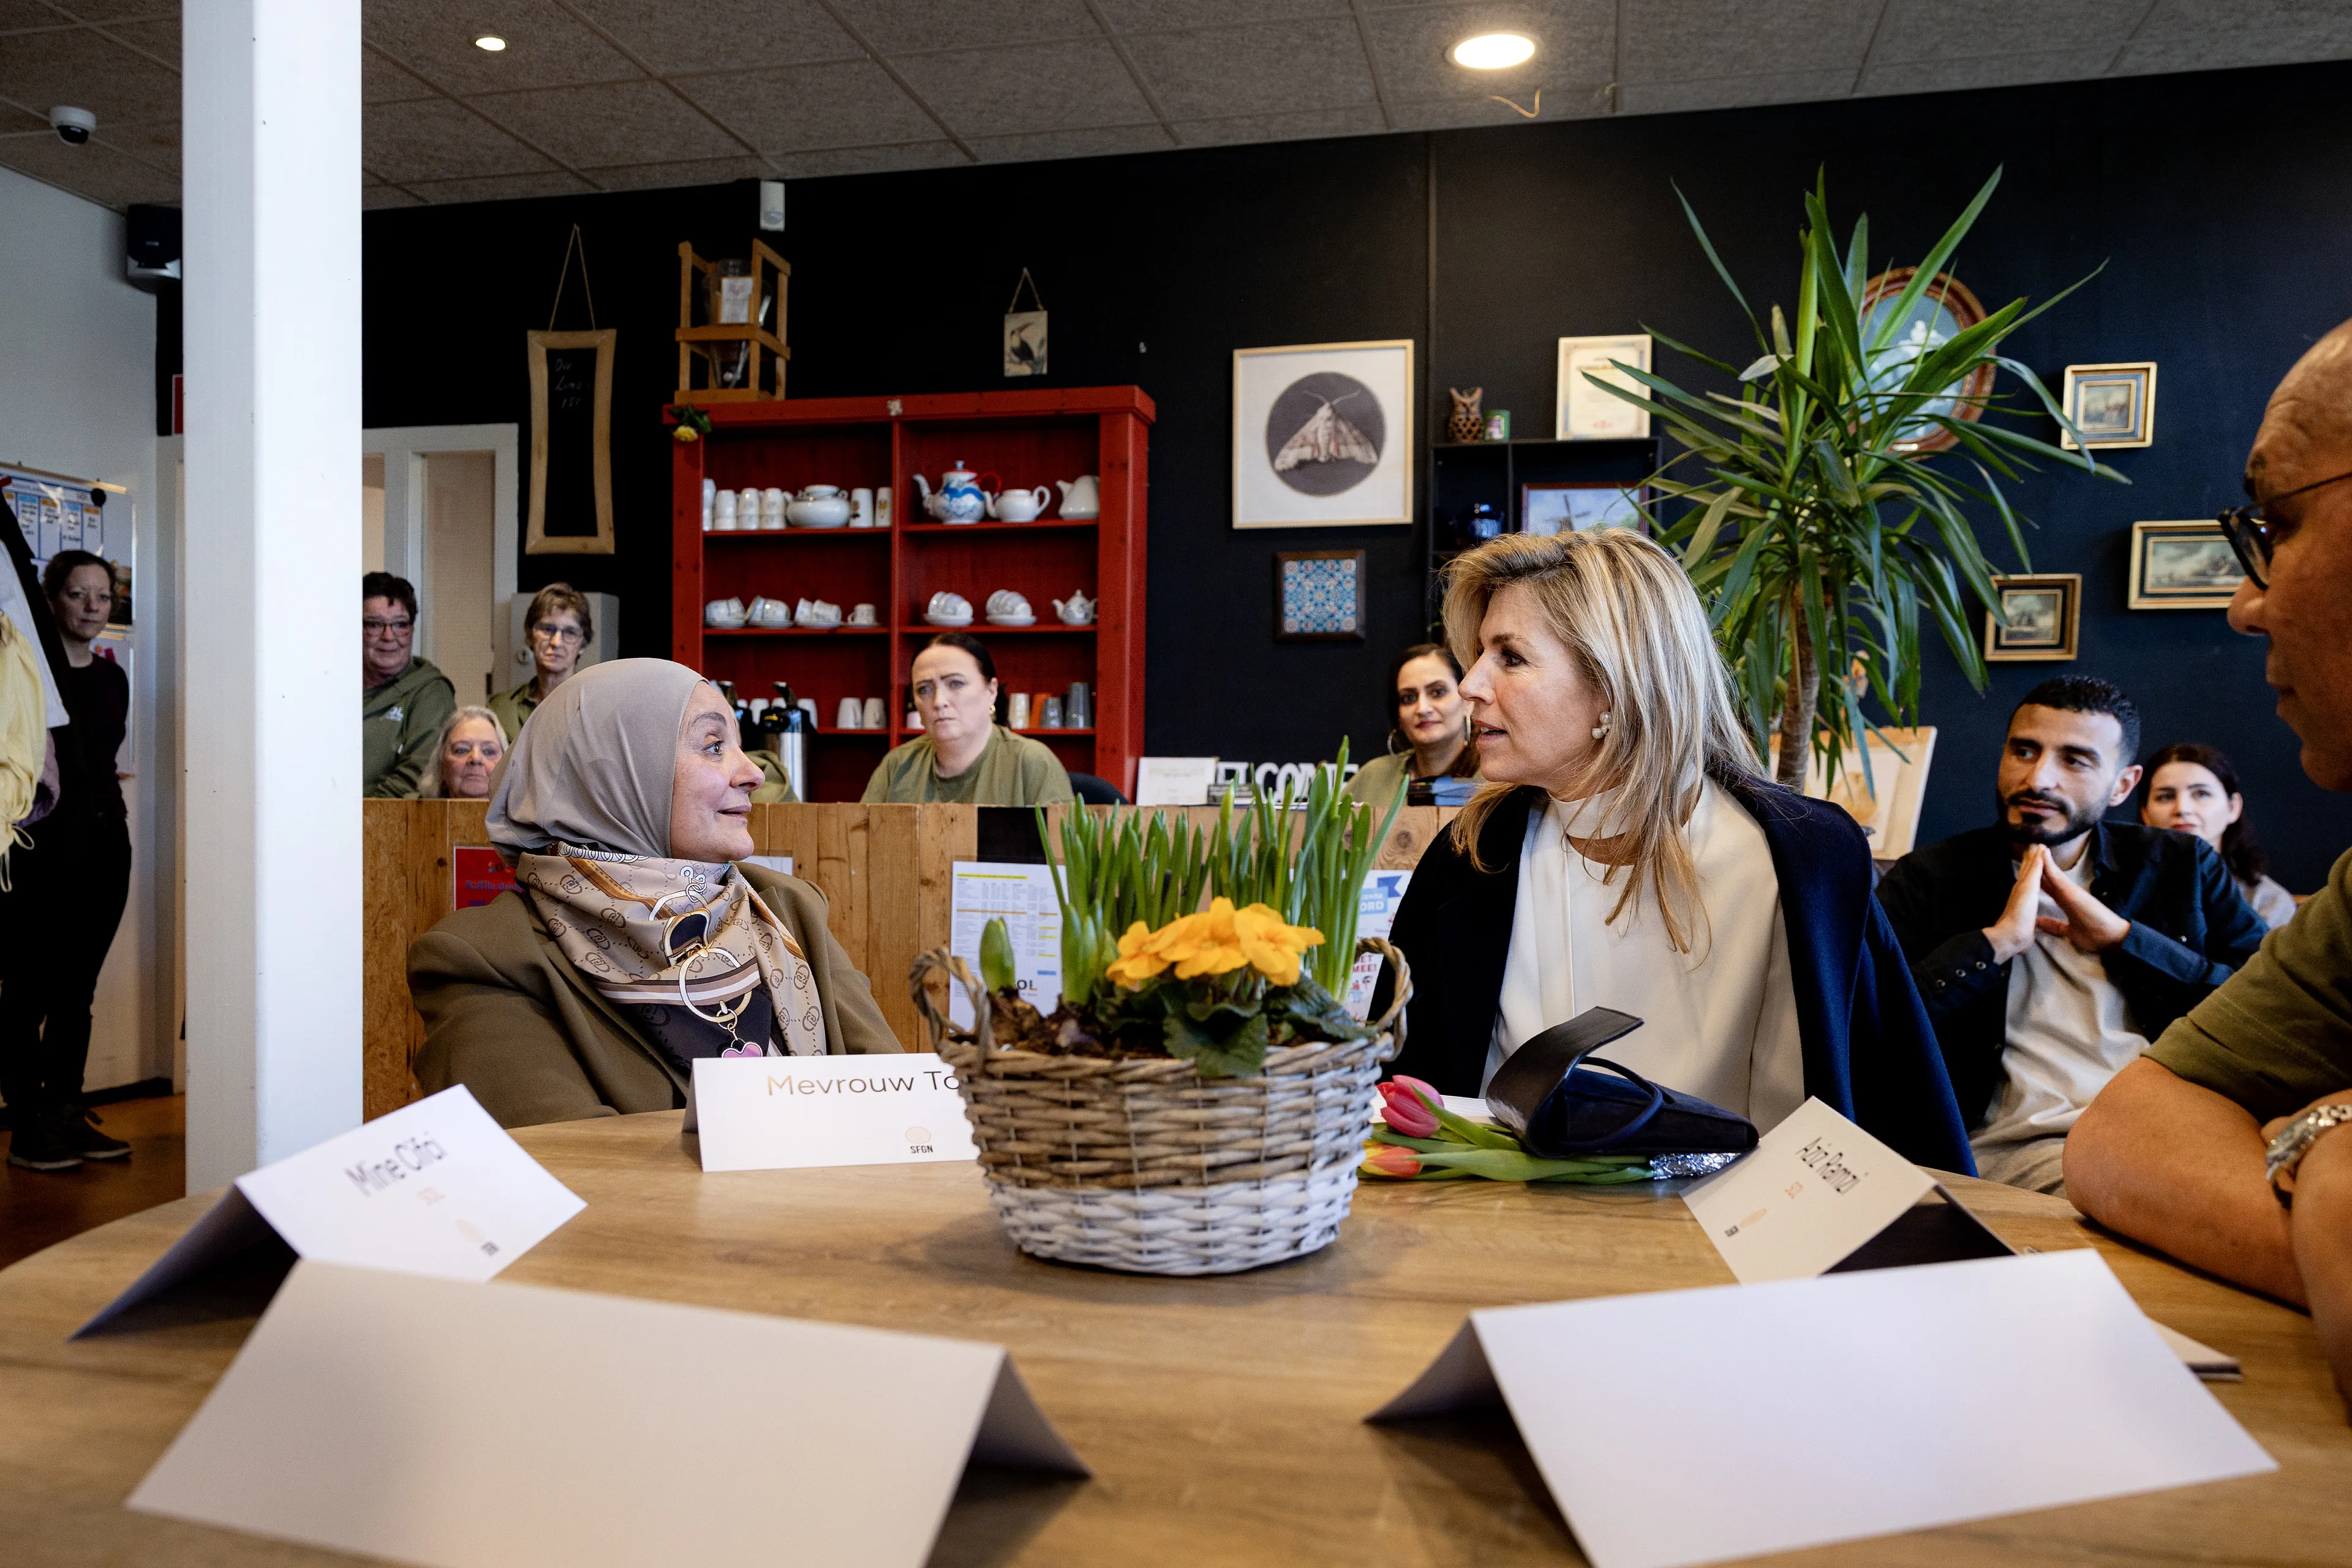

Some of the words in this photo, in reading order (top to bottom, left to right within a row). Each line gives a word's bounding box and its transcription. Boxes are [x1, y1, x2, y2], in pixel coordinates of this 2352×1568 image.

[1216, 761, 1359, 803] ELCOME
[1360, 902, 1384, 911] ORD
[1017, 979, 1038, 991] OL
[767, 1074, 914, 1096] Mevrouw
[910, 1144, 933, 1154] SFGN
[1795, 1136, 1833, 1169] Aziz
[1815, 1152, 1869, 1194] Ramzi
